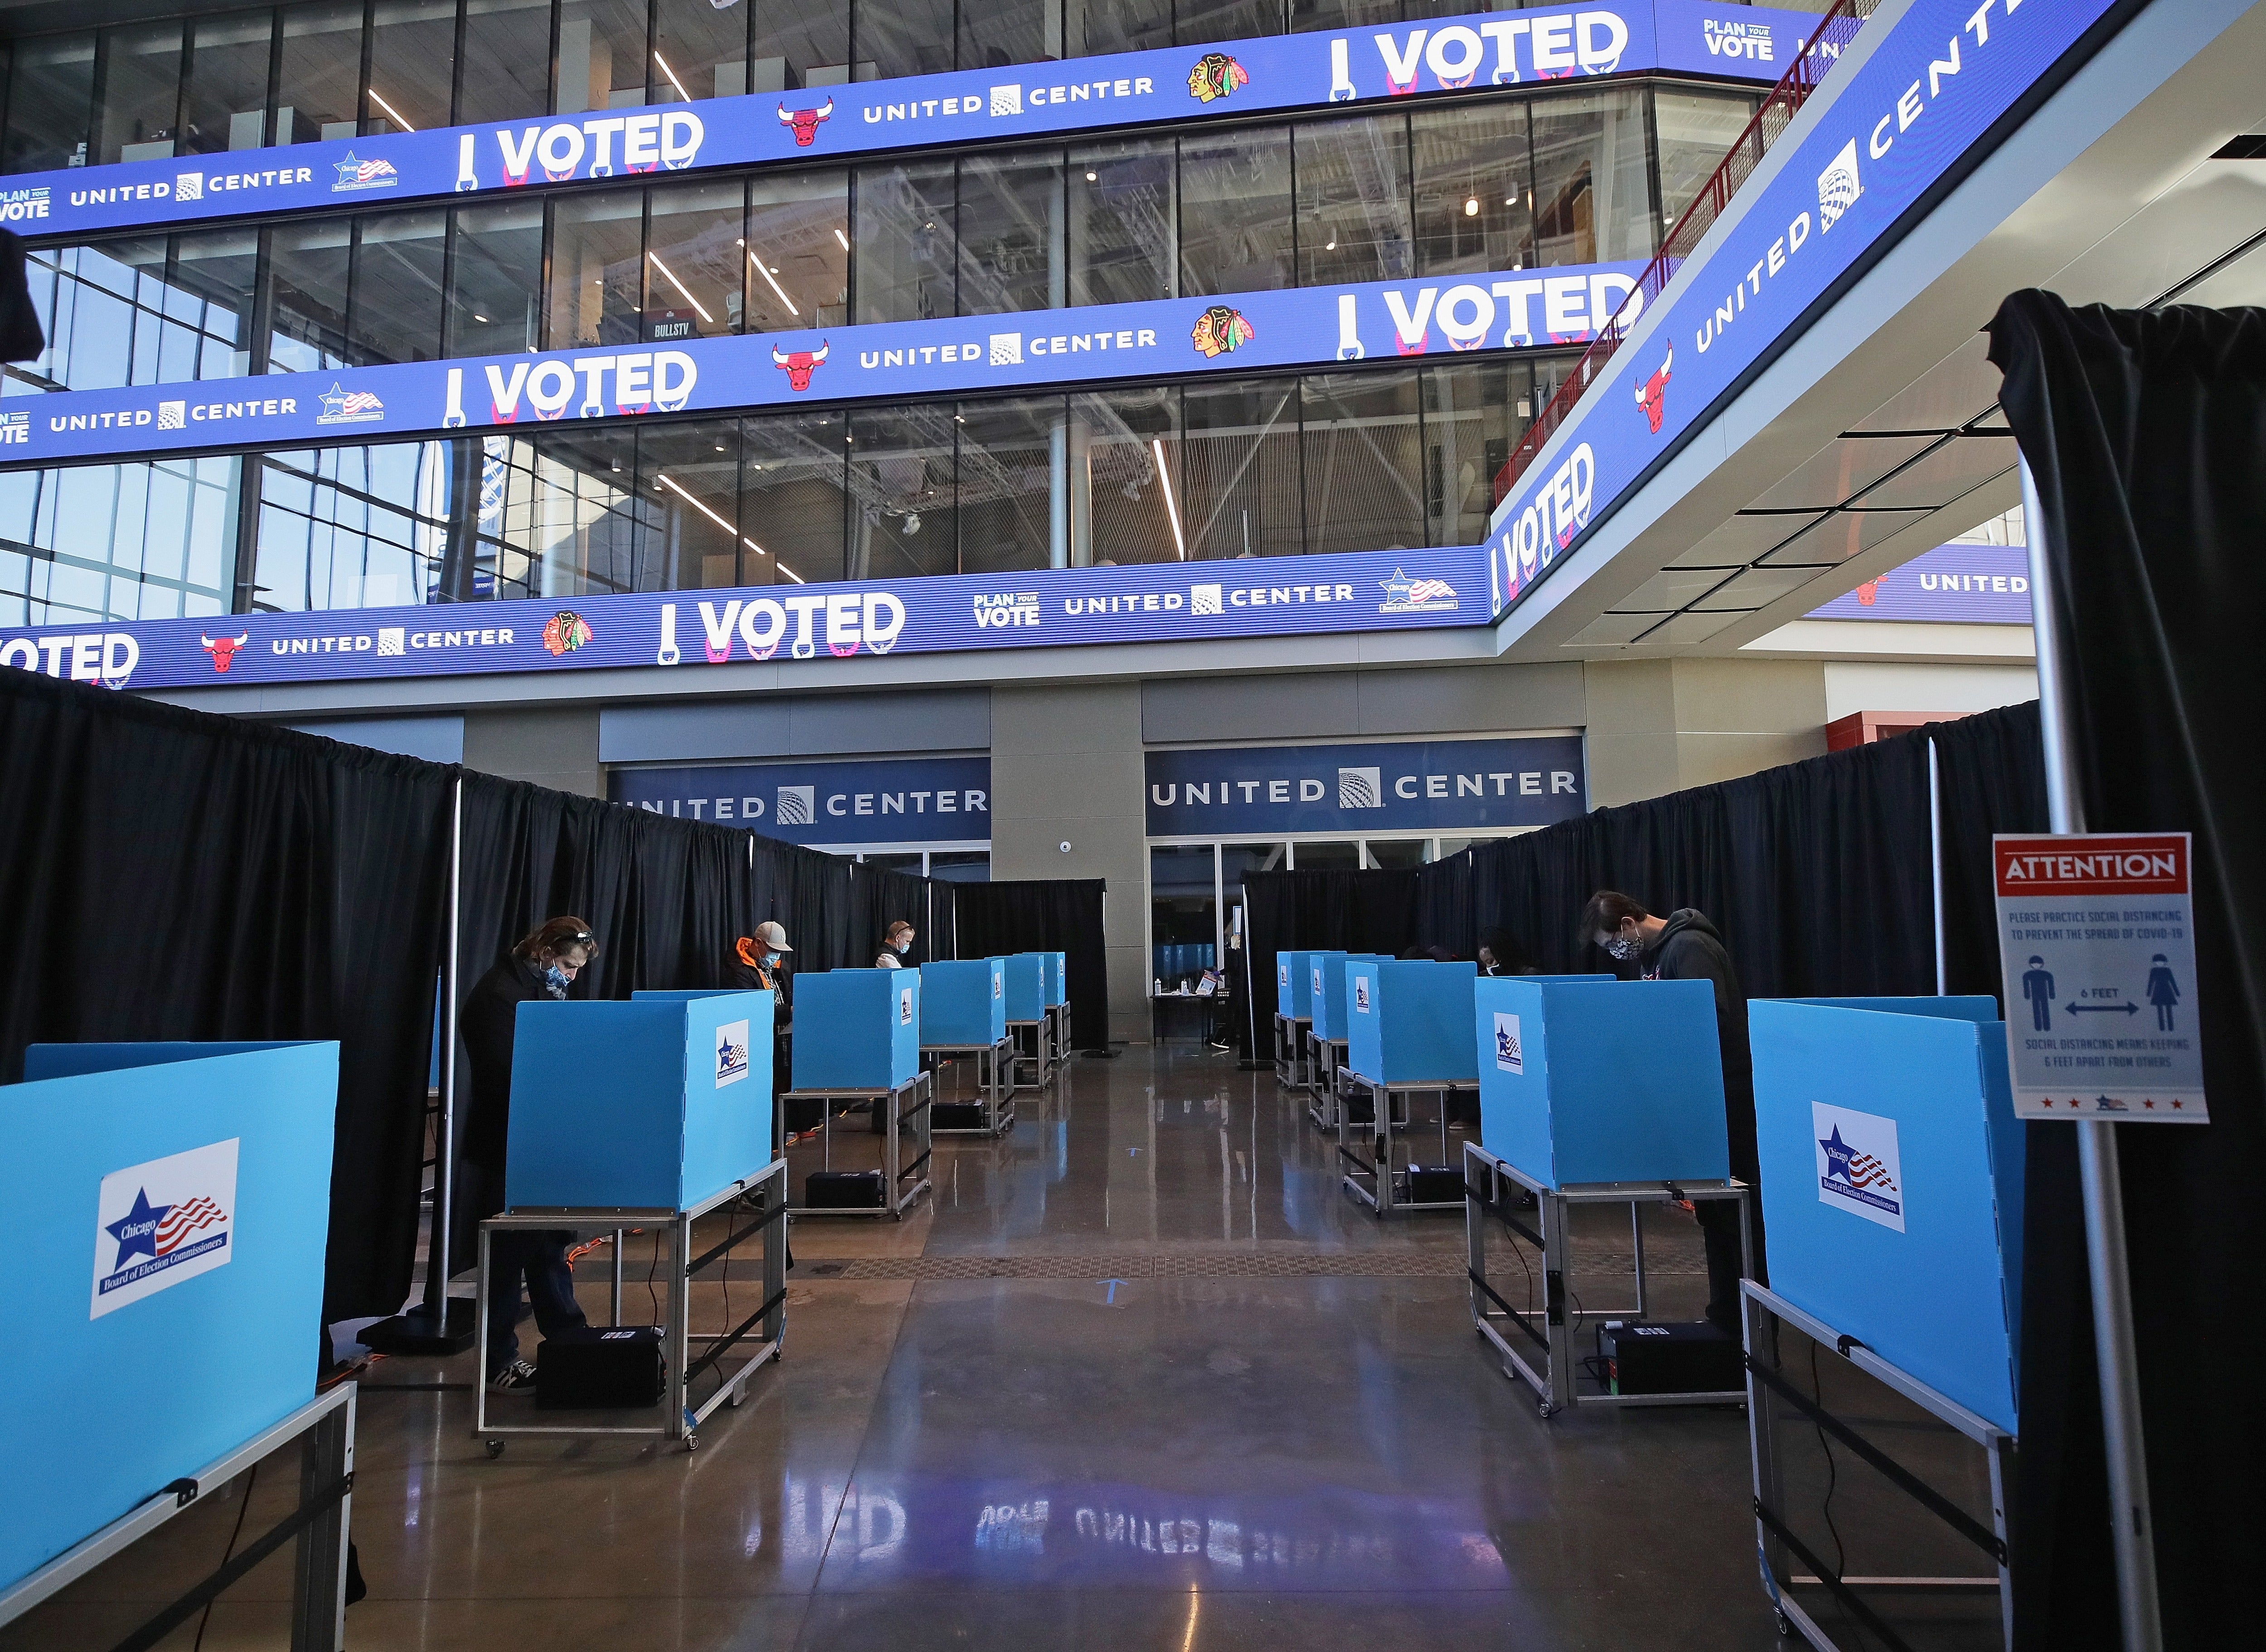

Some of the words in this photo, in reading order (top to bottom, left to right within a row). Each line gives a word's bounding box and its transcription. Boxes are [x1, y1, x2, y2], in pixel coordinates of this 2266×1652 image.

[1704, 19, 1746, 36] PLAN
[1749, 27, 1769, 36] YOUR
[1331, 39, 1349, 91] I
[1374, 10, 1628, 85] VOTED
[1704, 33, 1774, 61] VOTE
[863, 95, 983, 123] UNITED
[1030, 77, 1153, 106] CENTER
[459, 134, 475, 181] I
[496, 111, 704, 177] VOTED
[70, 183, 170, 206] UNITED
[208, 167, 312, 192] CENTER
[1696, 211, 1811, 354] UNITED
[1869, 0, 2023, 160] CENT
[1338, 295, 1357, 349] I
[1382, 273, 1644, 344] VOTED
[655, 322, 689, 337] BULLSTV
[860, 343, 982, 369] UNITED
[1030, 329, 1157, 356] CENTER
[446, 368, 462, 418] I
[484, 351, 697, 414] VOTED
[51, 410, 151, 432] UNITED
[191, 398, 297, 421] CENTER
[0, 424, 29, 444] TE
[1490, 547, 1499, 601] I
[1502, 442, 1595, 584] VOTED
[1389, 584, 1409, 592] Chicago
[1920, 573, 2028, 593] UNITED
[973, 593, 1015, 607] PLAN
[1065, 593, 1183, 615] UNITED
[1230, 584, 1354, 606] CENTER
[660, 604, 676, 652] I
[697, 592, 906, 650] VOTED
[973, 606, 1040, 628] VOTE
[0, 633, 140, 680] OTED
[272, 635, 372, 655] UNITED
[411, 628, 514, 649] CENTER
[1152, 779, 1325, 806] UNITED
[1395, 771, 1578, 799] CENTER
[613, 797, 765, 819] NITED
[827, 790, 988, 816] CENTER
[2006, 854, 2175, 880] ATTENTION
[2009, 912, 2039, 923] PLEASE
[2043, 911, 2085, 923] PRACTICE
[2088, 911, 2120, 923] SOCIAL
[2123, 911, 2182, 922] DISTANCING
[2012, 929, 2023, 940] TO
[2026, 929, 2063, 940] PREVENT
[2066, 929, 2083, 940] THE
[2085, 928, 2120, 940] SPREAD
[2123, 928, 2134, 940] OF
[2081, 989, 2088, 998] 6
[2092, 988, 2119, 998] FEET
[2025, 1038, 2057, 1050] SOCIAL
[2060, 1038, 2114, 1050] DISTANCING
[2044, 1056, 2051, 1067] 6
[2054, 1056, 2073, 1067] FEET
[2076, 1056, 2105, 1067] APART
[1828, 1147, 1848, 1163] Chicago
[1824, 1179, 1837, 1191] Board
[1838, 1183, 1842, 1192] of
[1843, 1186, 1860, 1199] Election
[1861, 1193, 1896, 1212] Commissioners
[121, 1220, 156, 1240] Chicago
[104, 1270, 128, 1291] Board
[129, 1267, 139, 1280] of
[139, 1258, 169, 1276] Election
[170, 1237, 223, 1264] Commissioners
